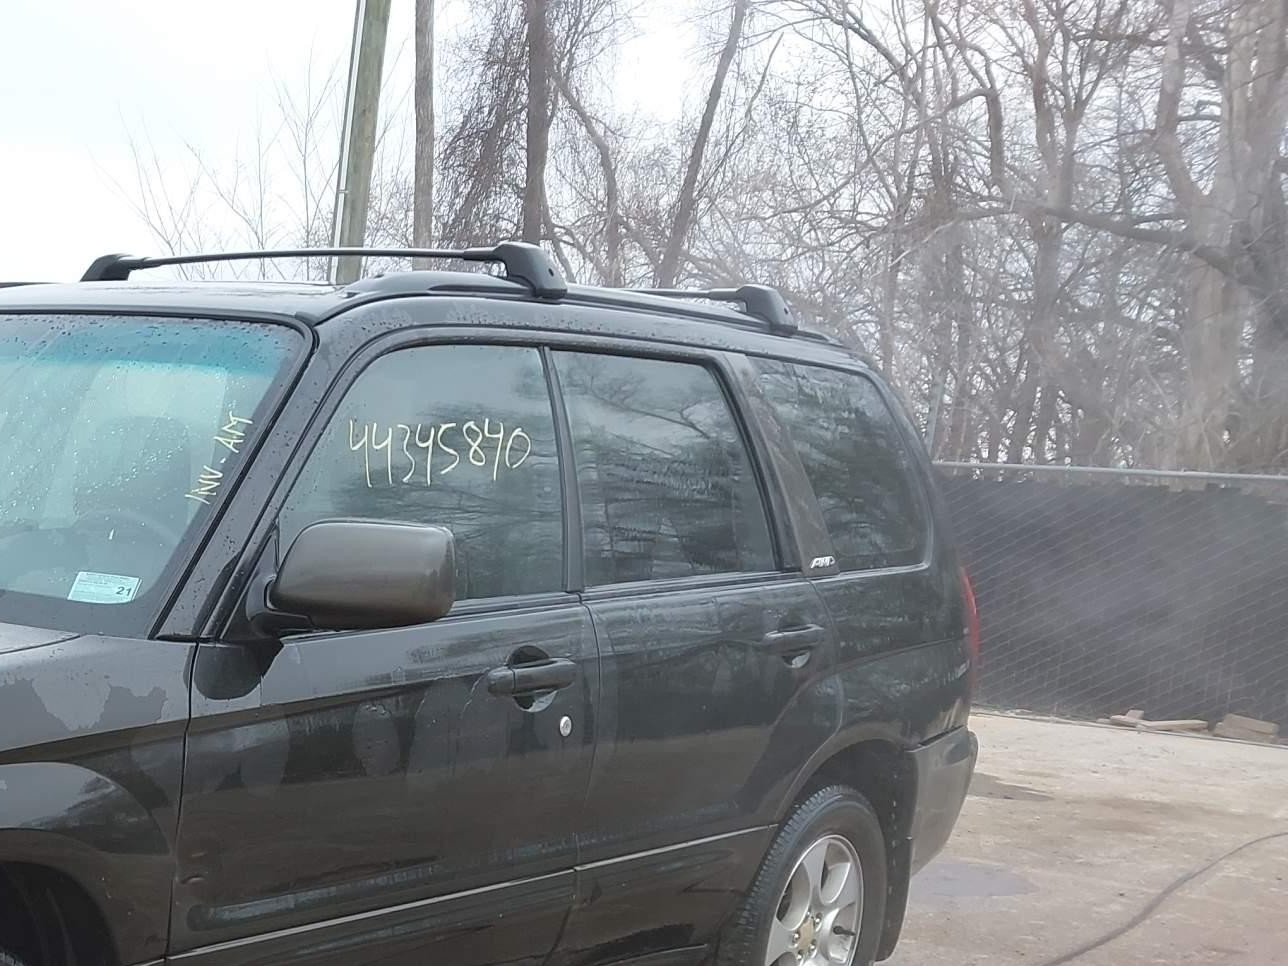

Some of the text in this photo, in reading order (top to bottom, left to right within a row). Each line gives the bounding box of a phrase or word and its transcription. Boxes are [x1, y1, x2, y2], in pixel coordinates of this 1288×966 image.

[349, 417, 532, 488] 44345840
[184, 464, 223, 505] INV
[116, 586, 132, 597] 21
